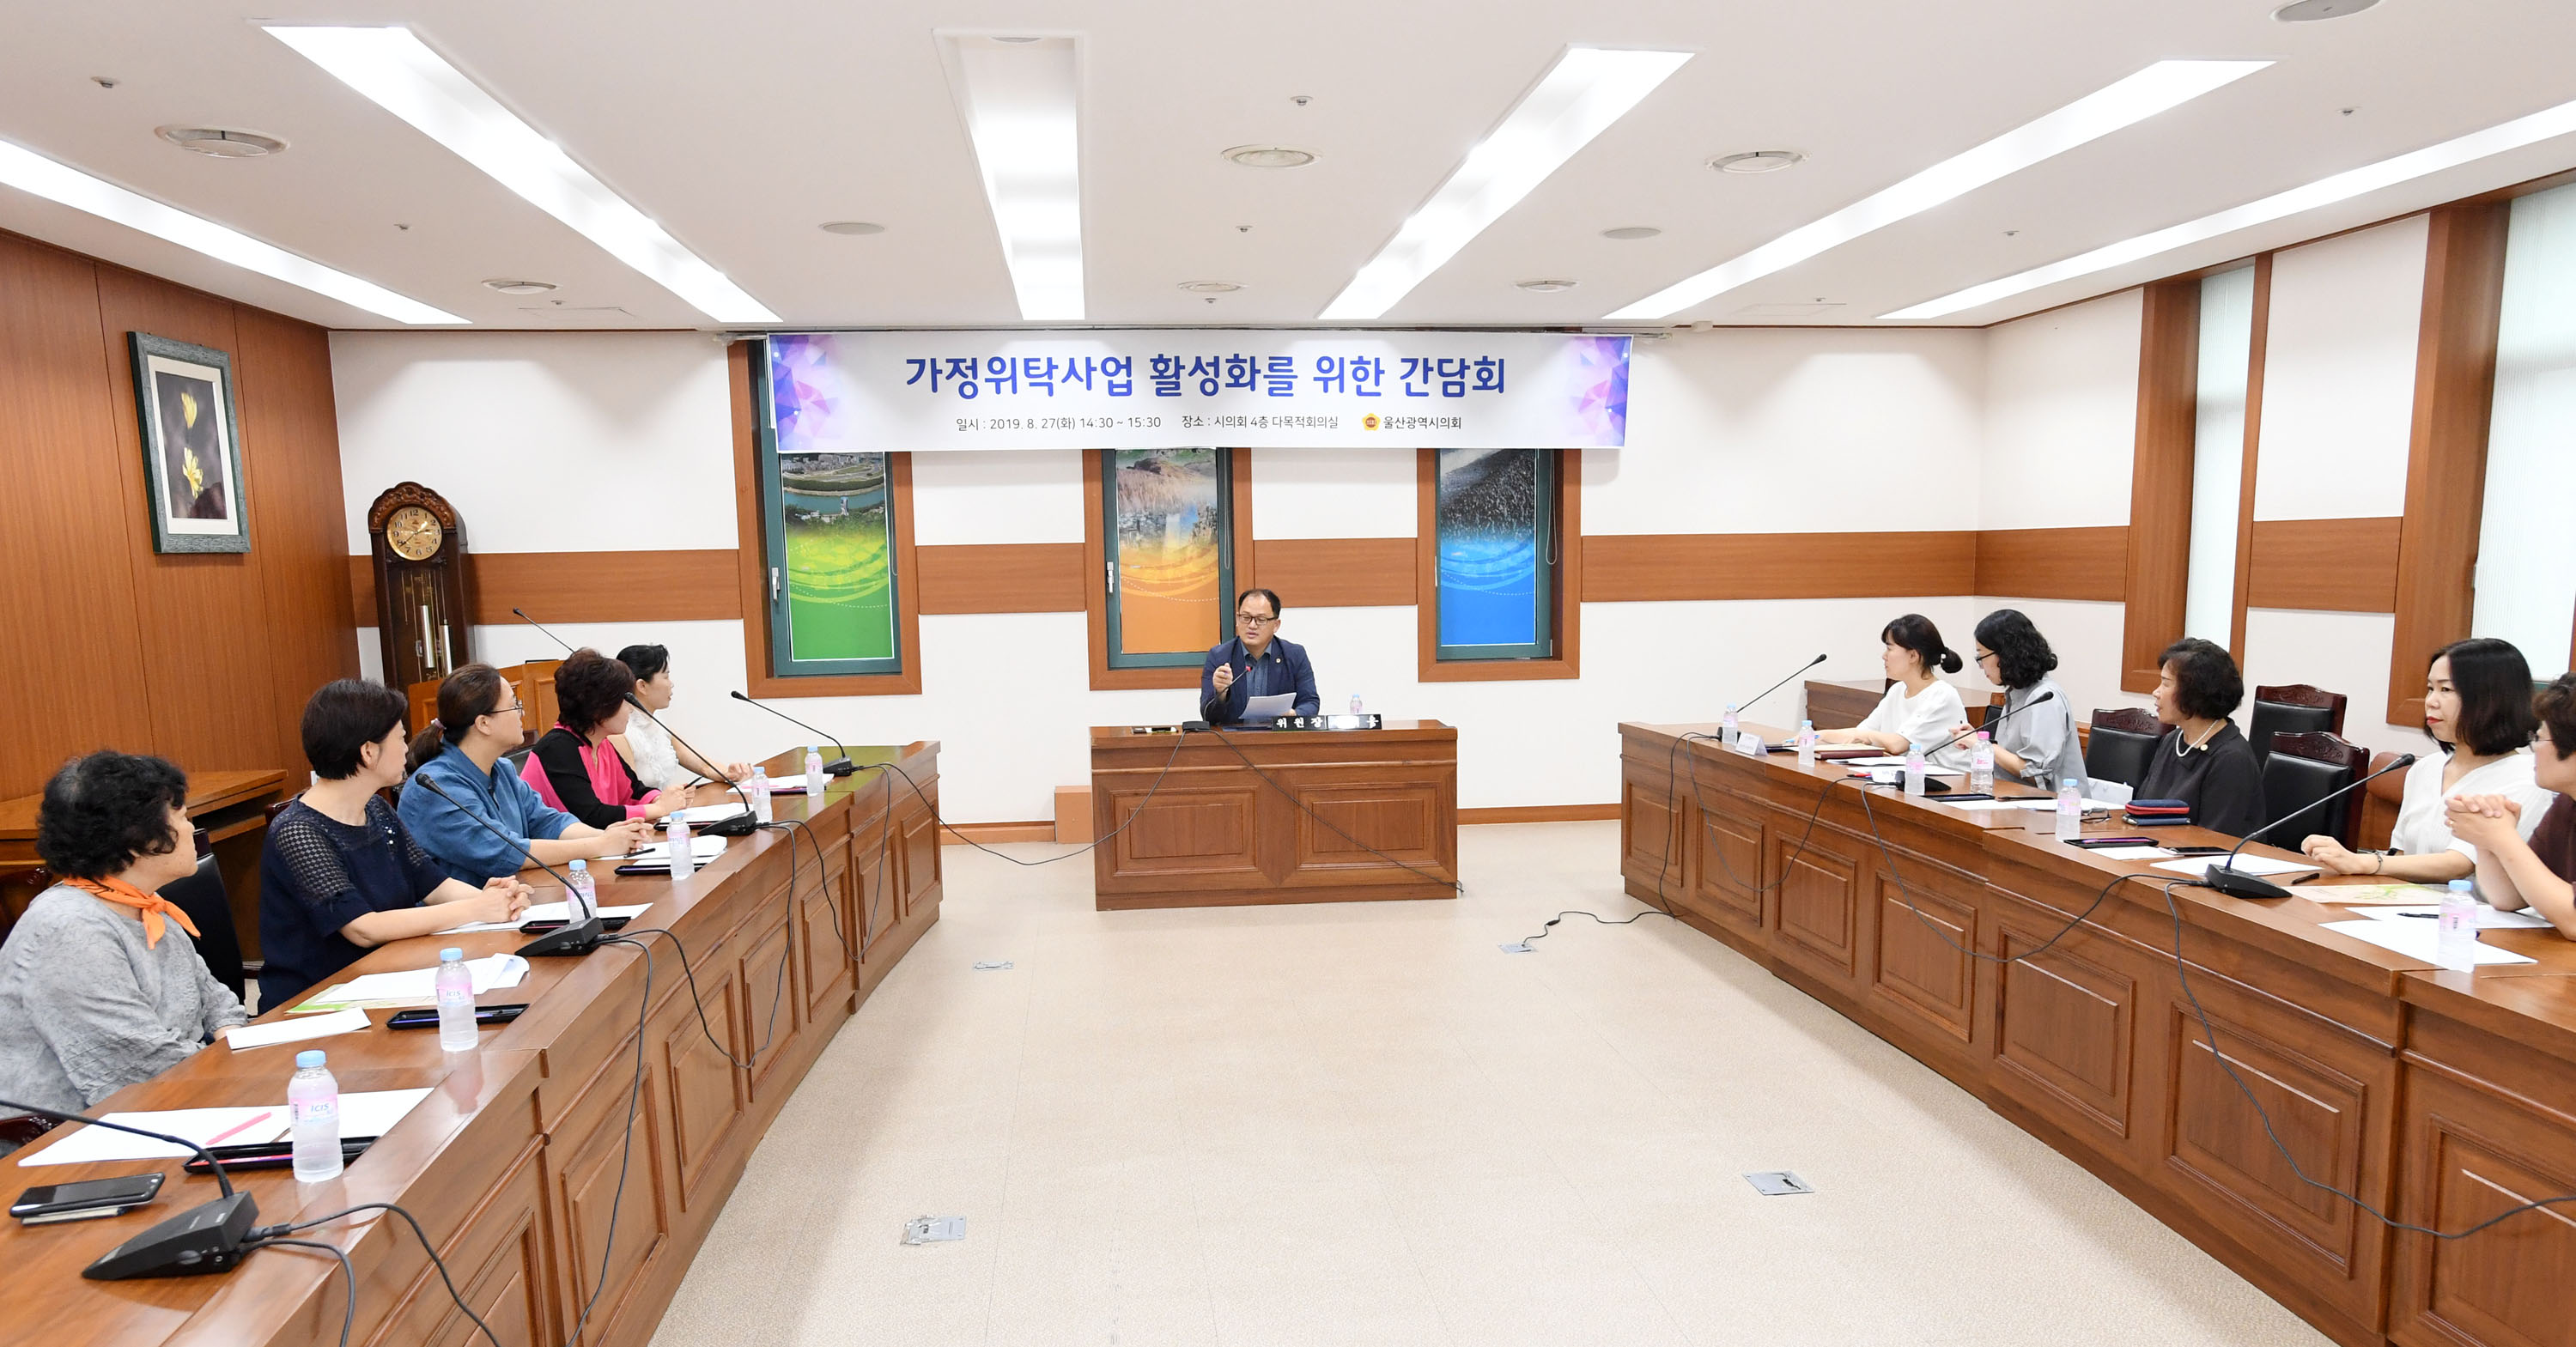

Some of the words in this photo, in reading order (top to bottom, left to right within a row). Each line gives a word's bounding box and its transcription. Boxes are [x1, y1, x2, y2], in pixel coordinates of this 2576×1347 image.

[906, 355, 1133, 400] 가정위탁사업
[1149, 353, 1298, 397] 활성화를
[1313, 355, 1386, 397] 위한
[1399, 355, 1505, 398] 간담회
[956, 418, 979, 432] 일시
[990, 418, 1024, 430] 2019.
[1027, 418, 1038, 429] 8.
[1041, 416, 1076, 430] 27(화)
[1079, 417, 1114, 428] 14:30
[1127, 416, 1162, 428] 15:30
[1181, 415, 1205, 429] 장소
[1213, 415, 1248, 429] 시의회
[1249, 416, 1269, 429] 4층
[1272, 416, 1338, 429] 다목적회의실
[1382, 416, 1461, 430] 울산광역시의회
